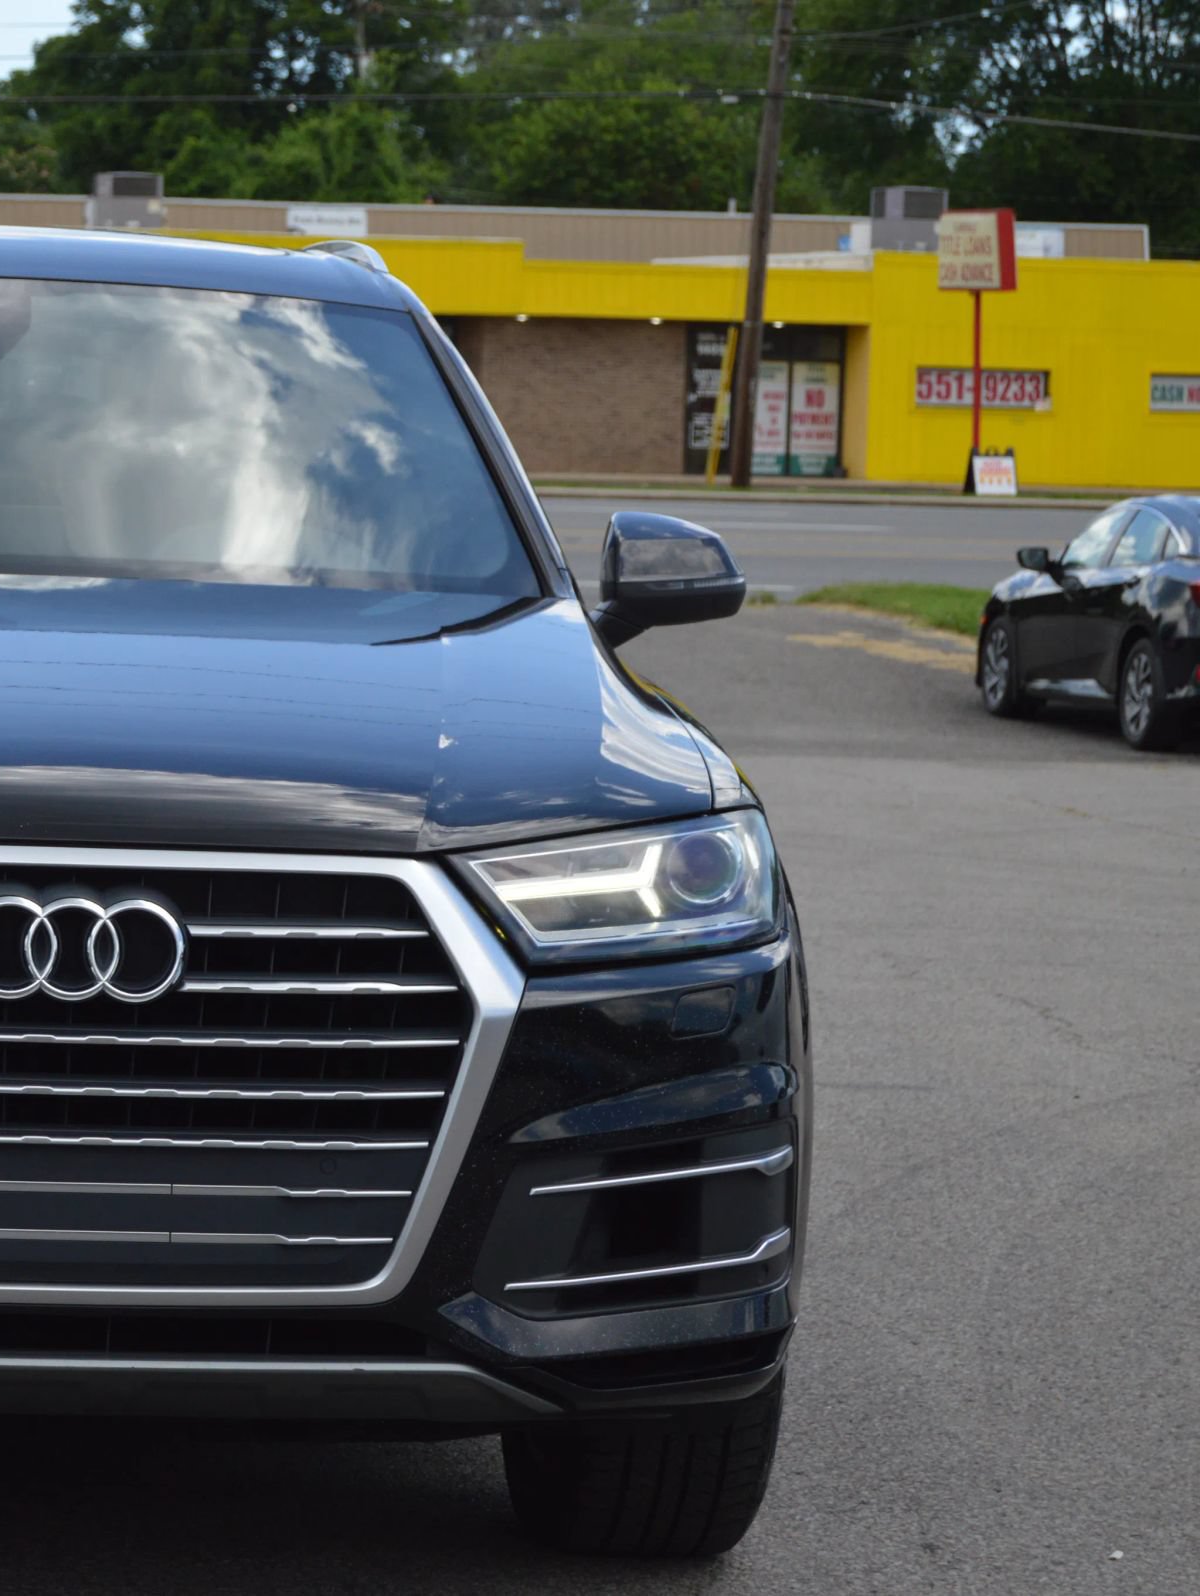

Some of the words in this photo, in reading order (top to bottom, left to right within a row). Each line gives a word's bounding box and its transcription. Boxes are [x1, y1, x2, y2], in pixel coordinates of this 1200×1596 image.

[963, 234, 992, 257] LOANS
[960, 262, 993, 283] ADVANCE
[804, 388, 825, 408] NO
[1151, 383, 1184, 402] CASH
